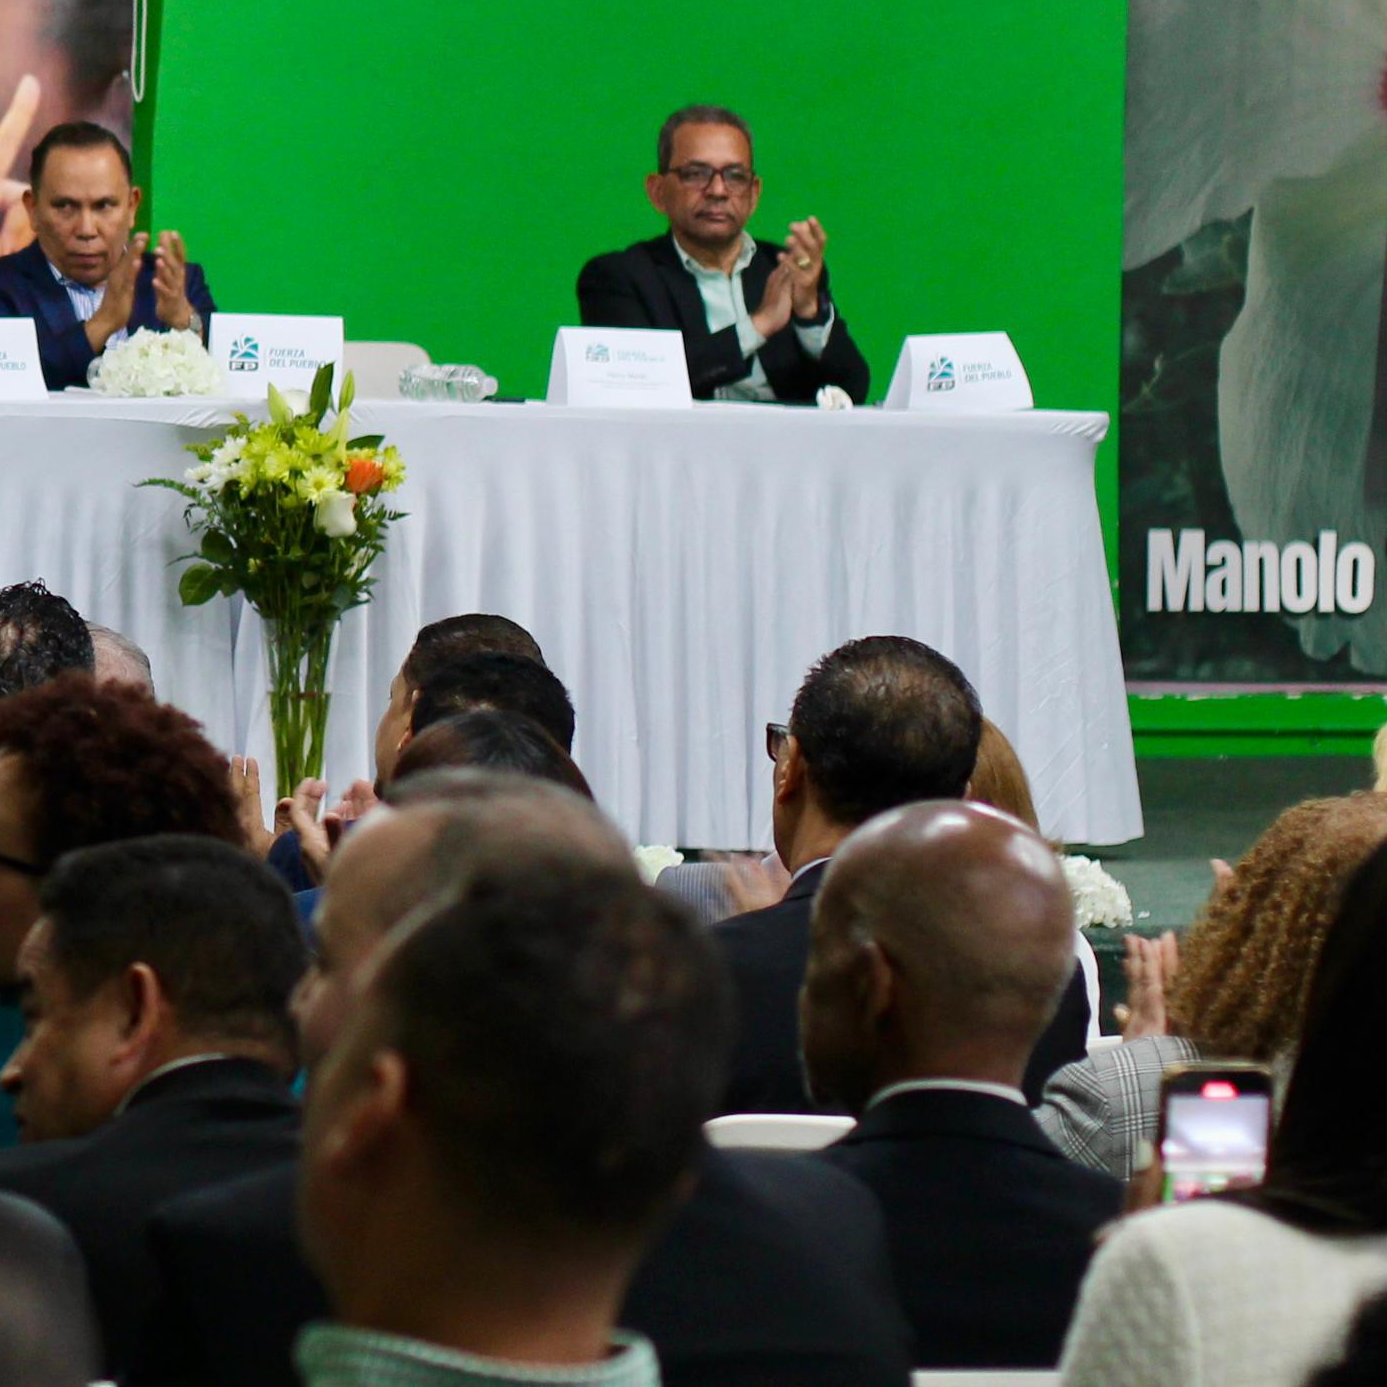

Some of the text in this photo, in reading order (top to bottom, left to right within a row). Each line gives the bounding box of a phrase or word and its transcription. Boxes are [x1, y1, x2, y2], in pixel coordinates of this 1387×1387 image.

[269, 348, 306, 357] FUERZA
[269, 359, 287, 368] DEL
[1147, 527, 1376, 614] Manolo
